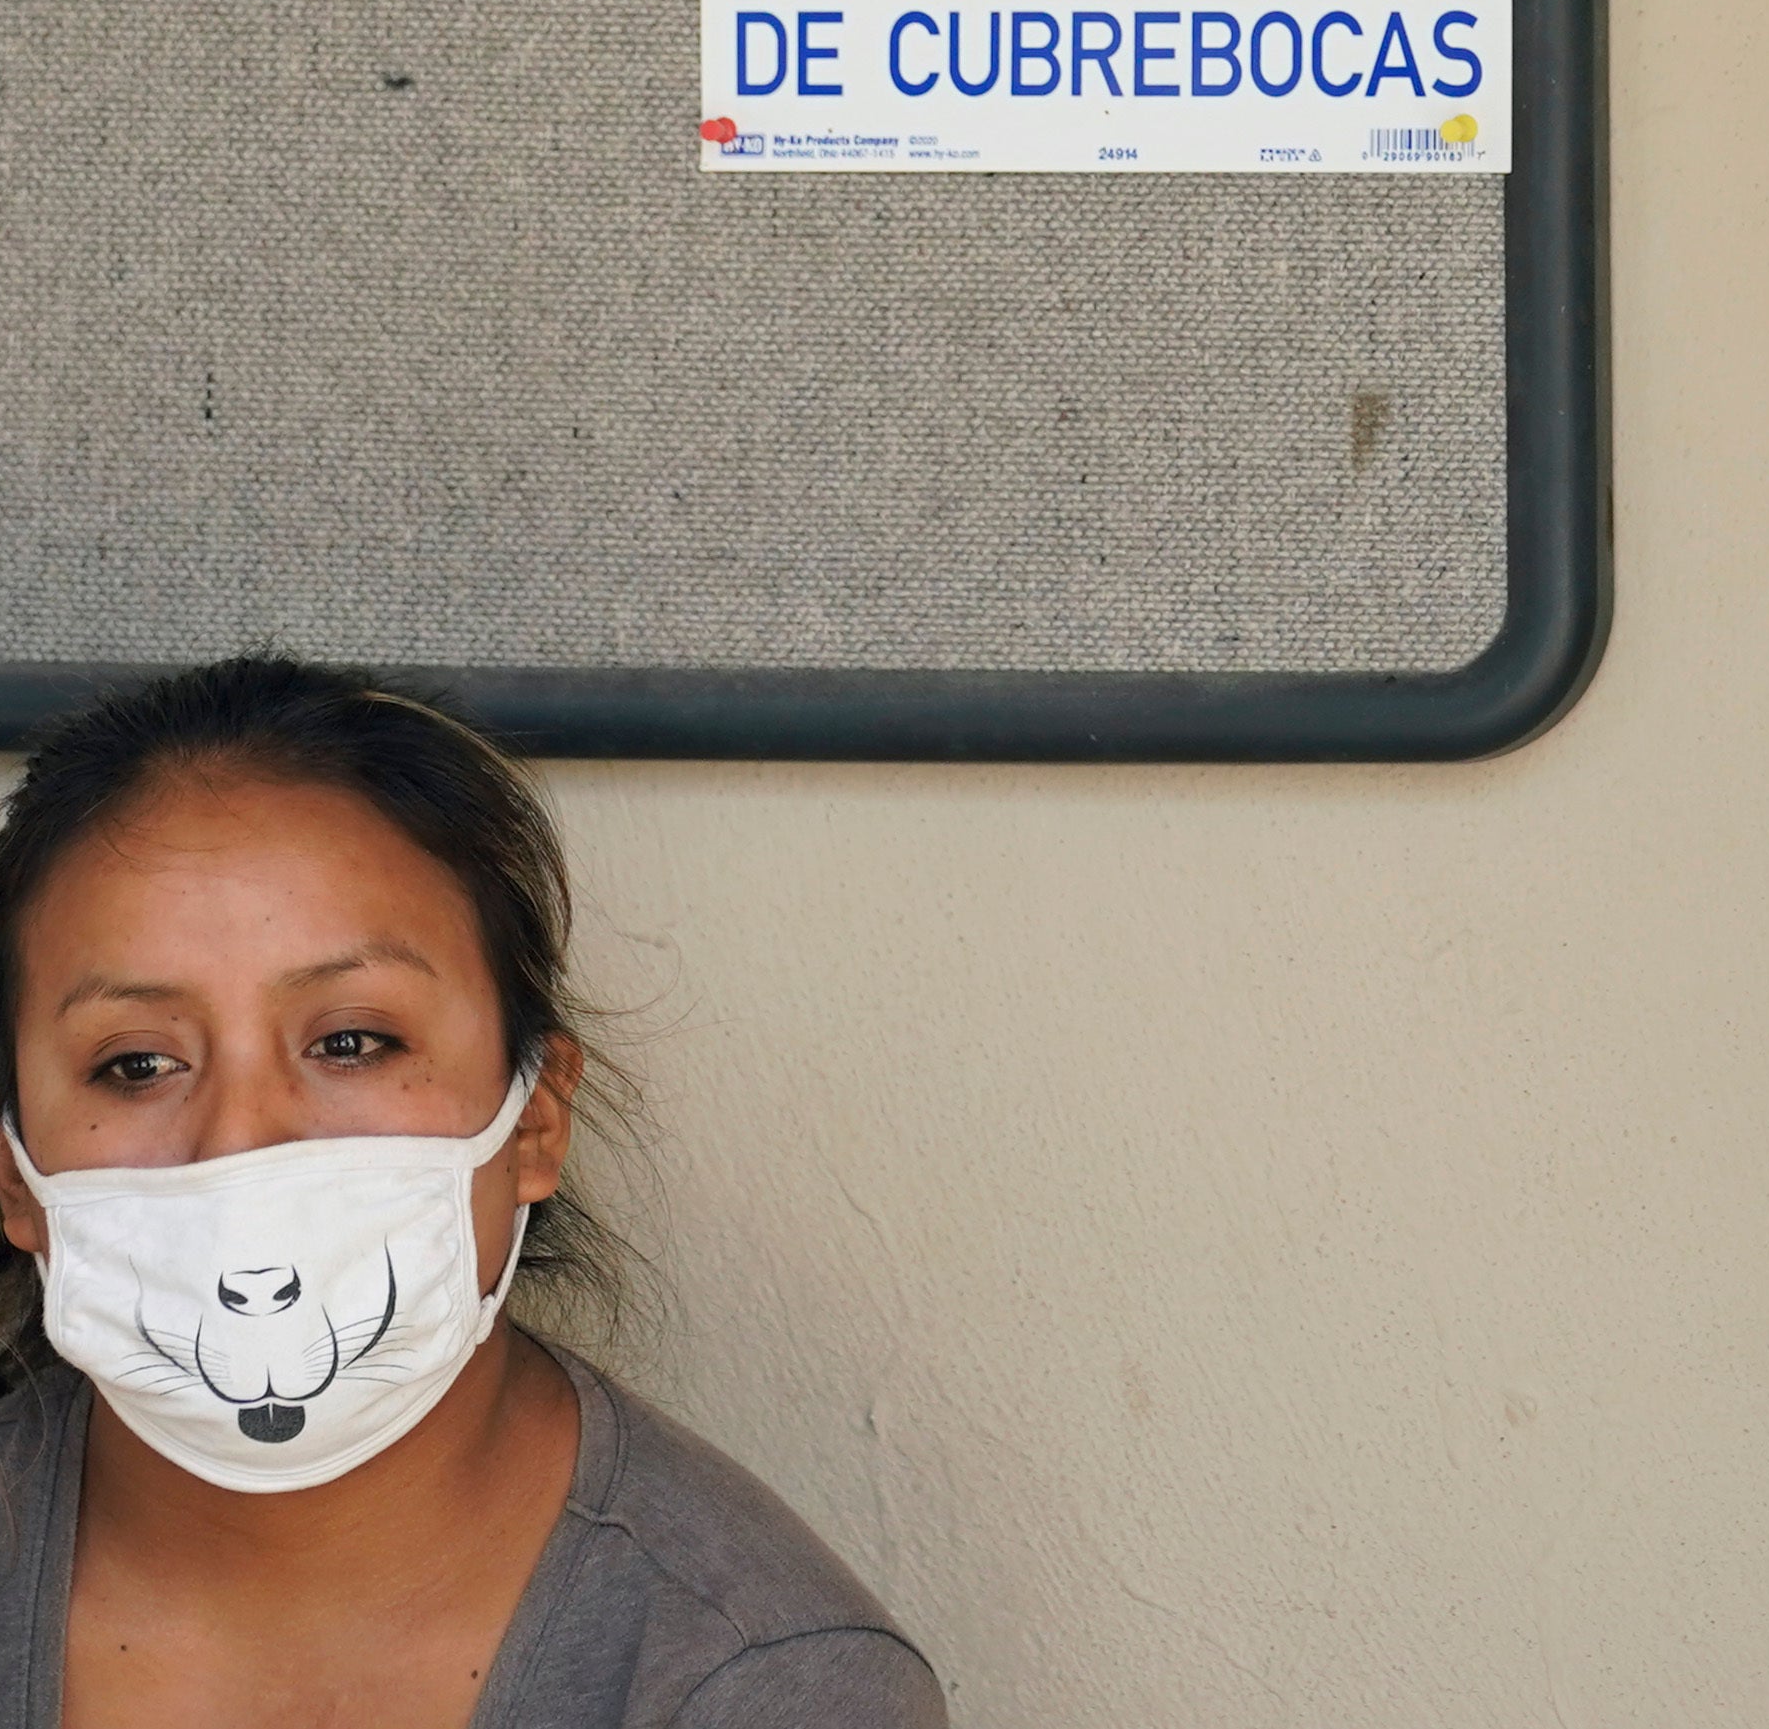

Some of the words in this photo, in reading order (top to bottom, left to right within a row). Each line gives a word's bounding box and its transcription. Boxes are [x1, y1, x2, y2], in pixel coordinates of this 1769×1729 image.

[735, 11, 844, 98] DE
[887, 10, 1485, 100] CUBREBOCAS
[806, 135, 850, 146] Products
[854, 135, 899, 148] Company
[1098, 147, 1139, 160] 24914
